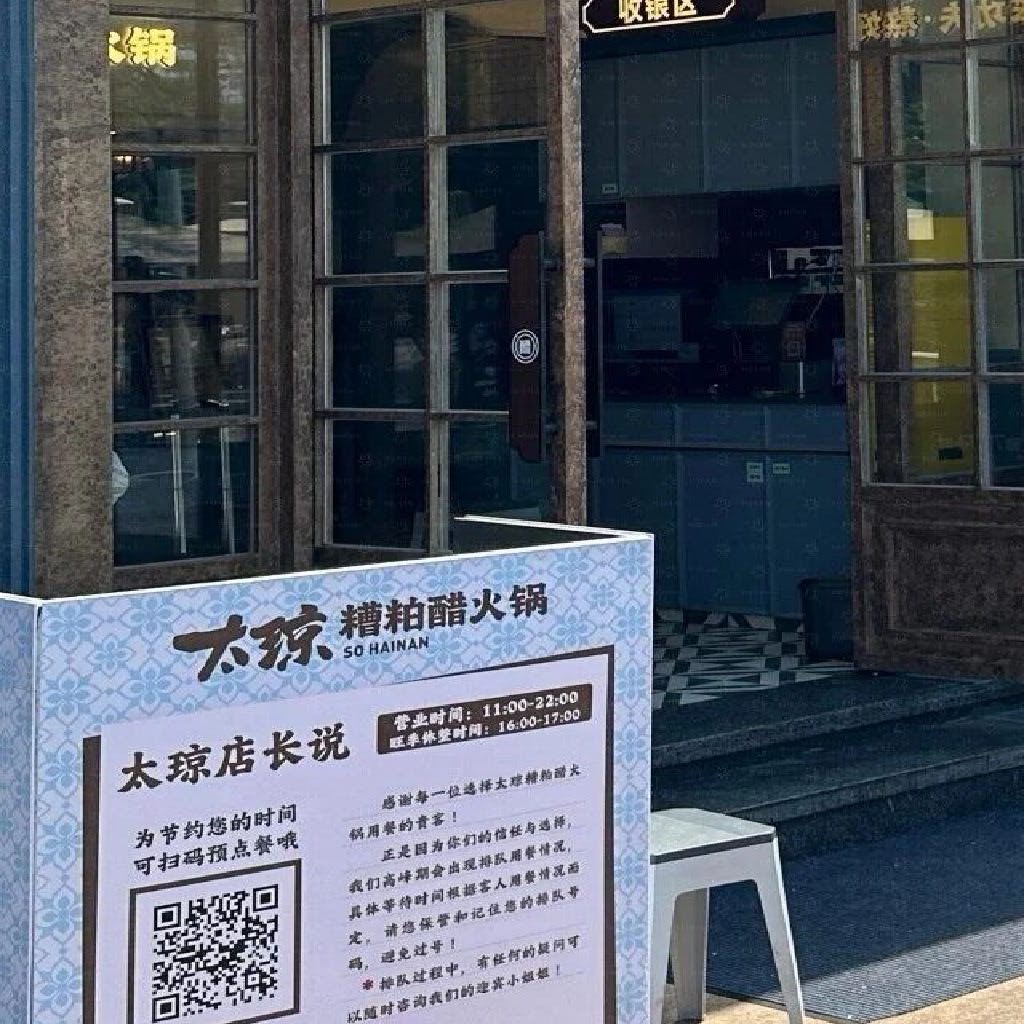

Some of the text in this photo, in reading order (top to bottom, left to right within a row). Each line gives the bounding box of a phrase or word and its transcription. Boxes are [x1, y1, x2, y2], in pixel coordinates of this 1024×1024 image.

[339, 582, 549, 640] 糟粕醋火锅
[172, 603, 334, 682] 太琼
[343, 635, 431, 659] SO HAINAN
[117, 722, 350, 793] 太琼店长说
[135, 803, 297, 849] 为节约您的时间
[133, 830, 299, 876] 可扫码预点餐哦
